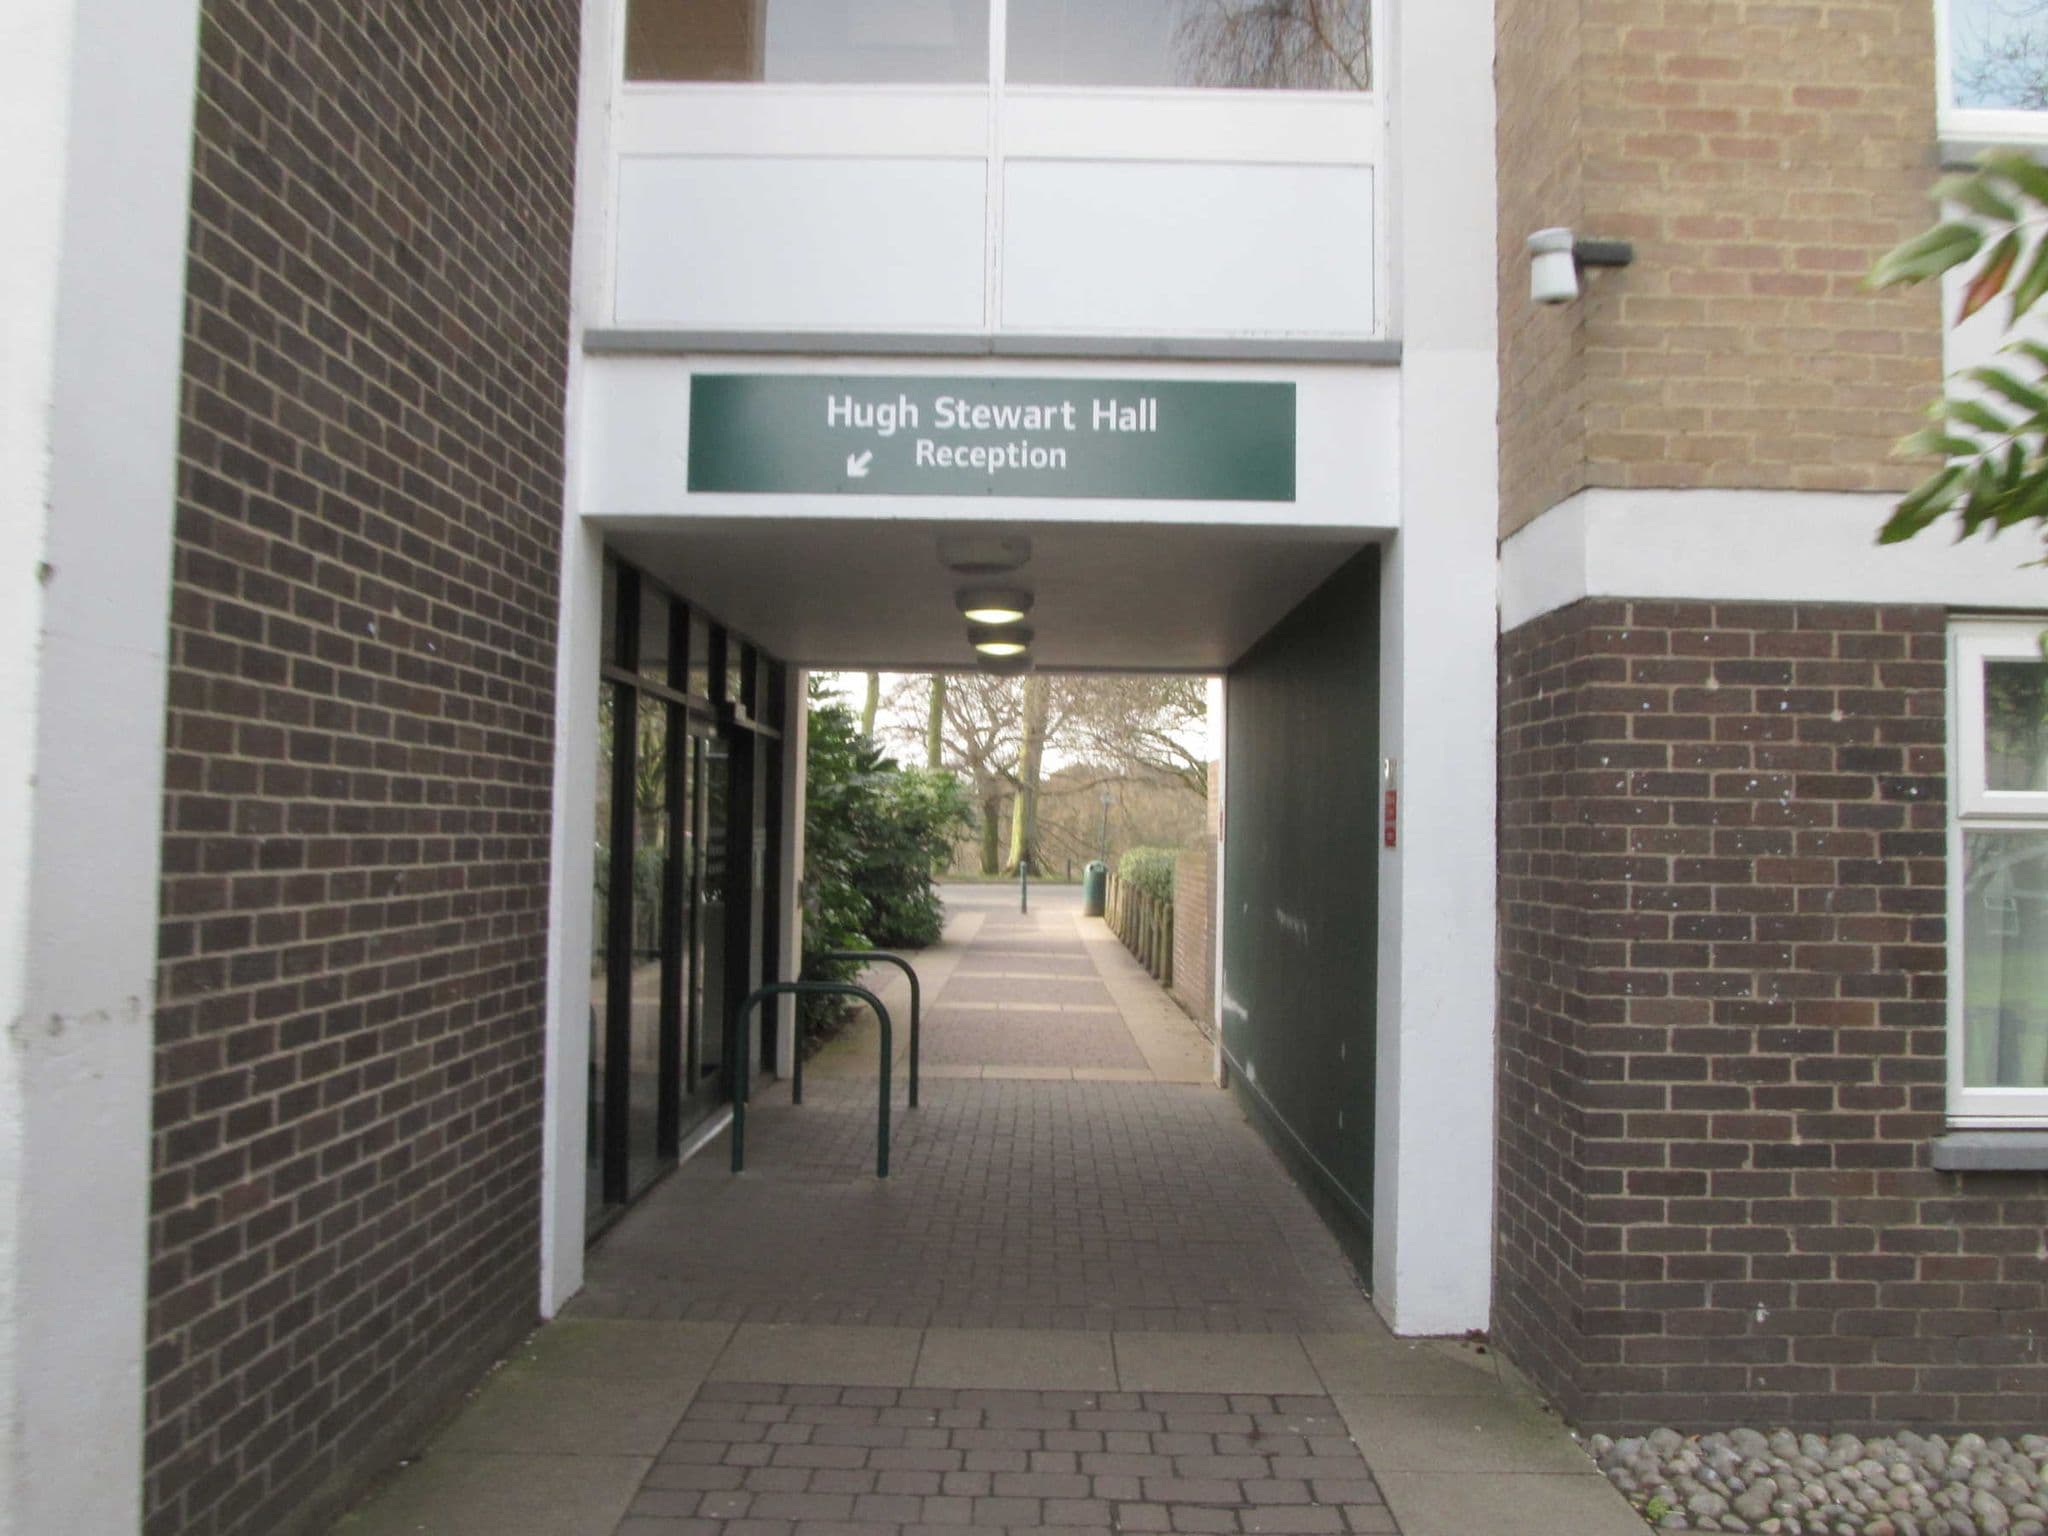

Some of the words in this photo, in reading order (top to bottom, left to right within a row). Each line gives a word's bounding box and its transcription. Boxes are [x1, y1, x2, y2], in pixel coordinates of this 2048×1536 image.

[826, 394, 919, 437] Hugh
[933, 396, 1076, 433] Stewart
[1092, 398, 1158, 433] Hall
[915, 439, 1067, 474] Reception
